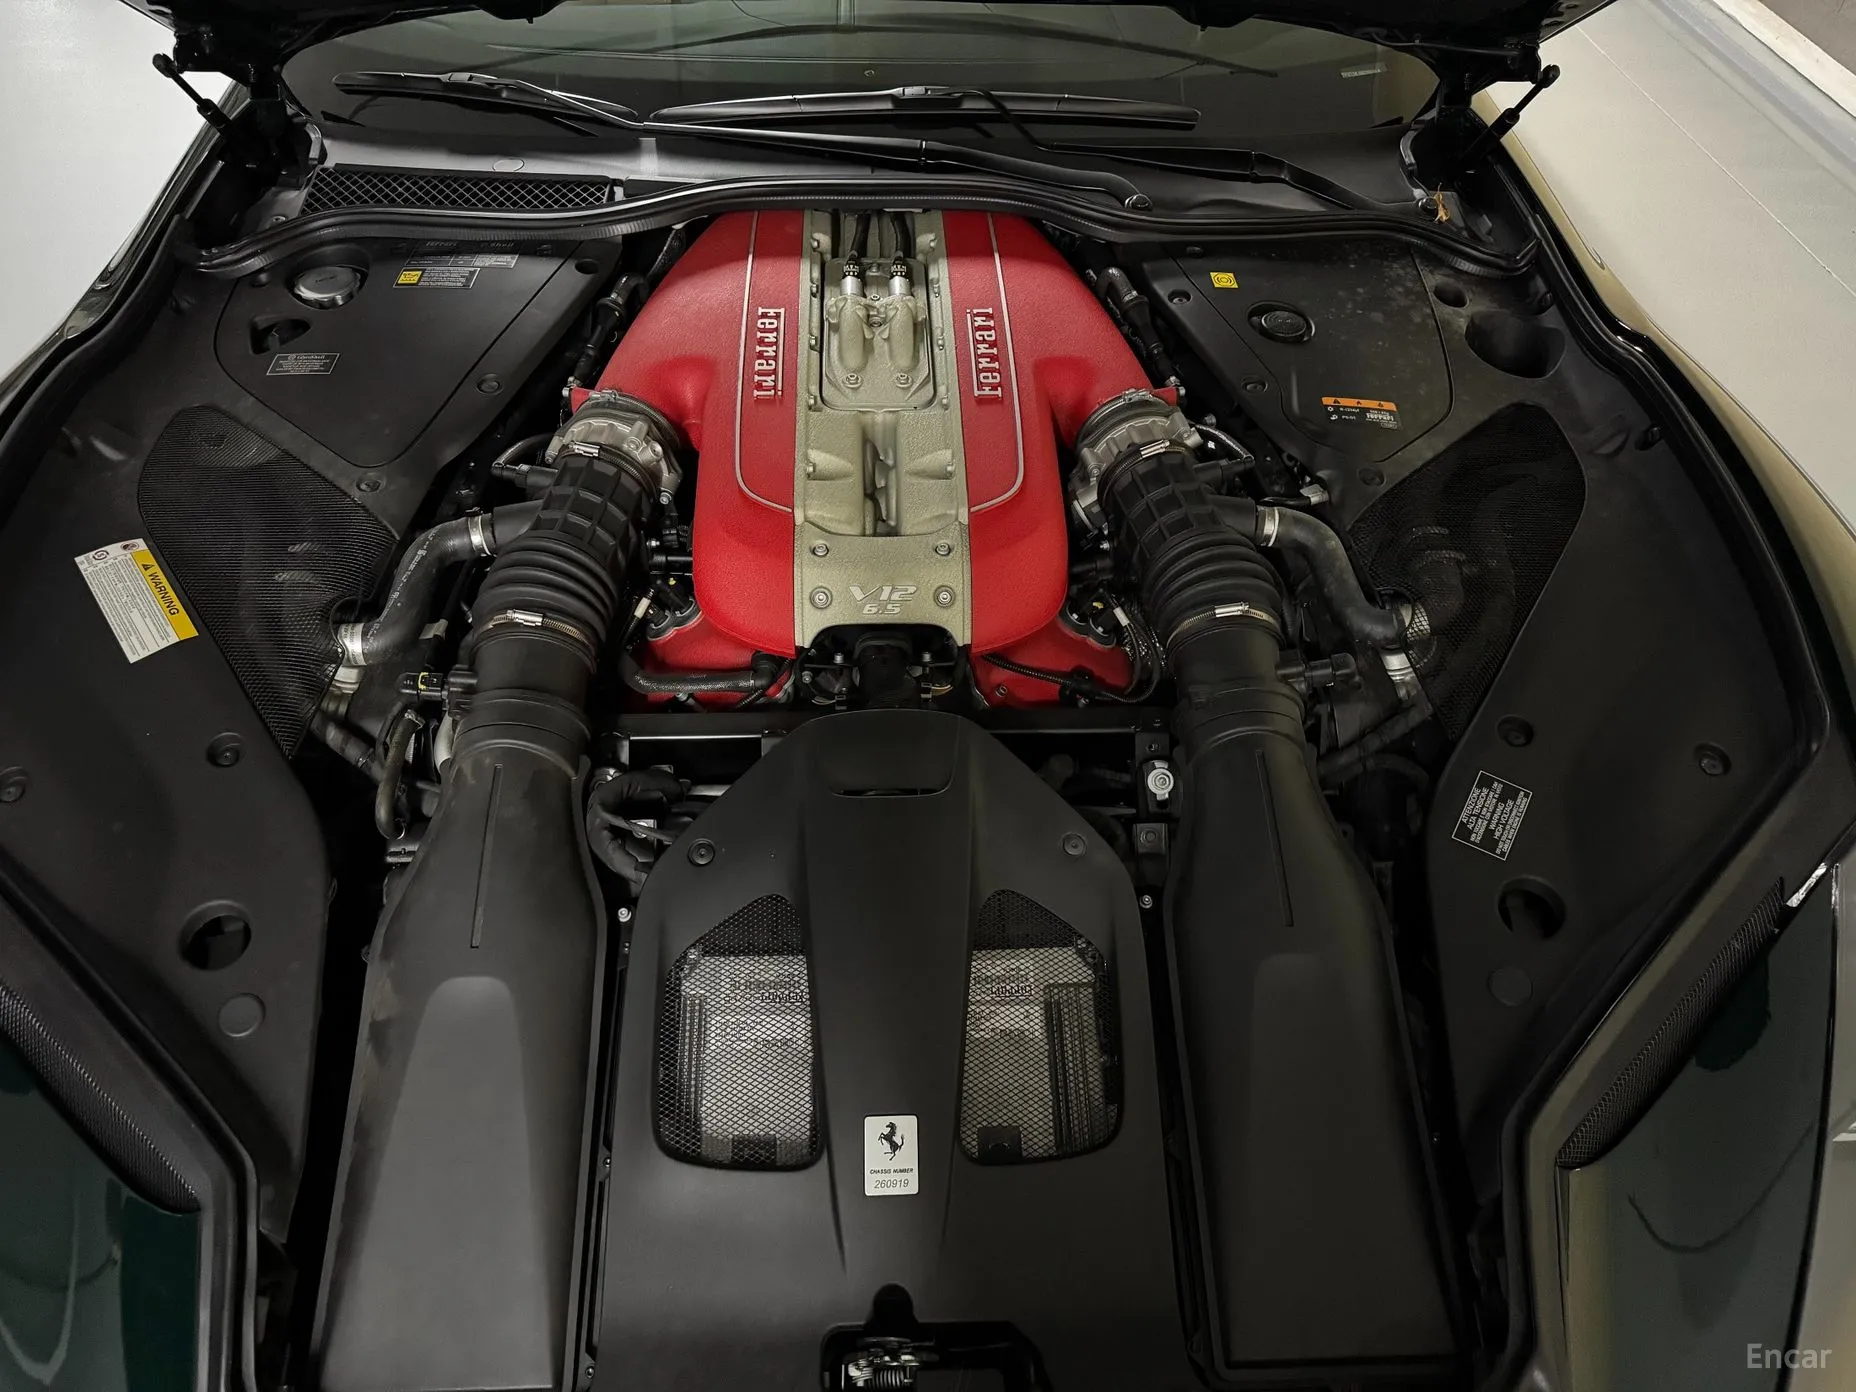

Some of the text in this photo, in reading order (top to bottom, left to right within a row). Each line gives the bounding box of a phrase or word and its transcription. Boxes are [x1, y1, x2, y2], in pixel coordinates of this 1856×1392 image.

[754, 306, 785, 400] Ferrari
[966, 308, 1002, 397] Ferrari
[148, 572, 180, 616] WARNING
[849, 585, 917, 602] V12
[862, 604, 902, 615] 6.5
[1462, 788, 1481, 823] ATTENZIONE
[1467, 787, 1489, 829] ALTA TENSIONE
[1489, 802, 1505, 830] WARNING
[1493, 799, 1514, 839] HIGH VOLTAGE
[874, 1178, 910, 1189] 260919
